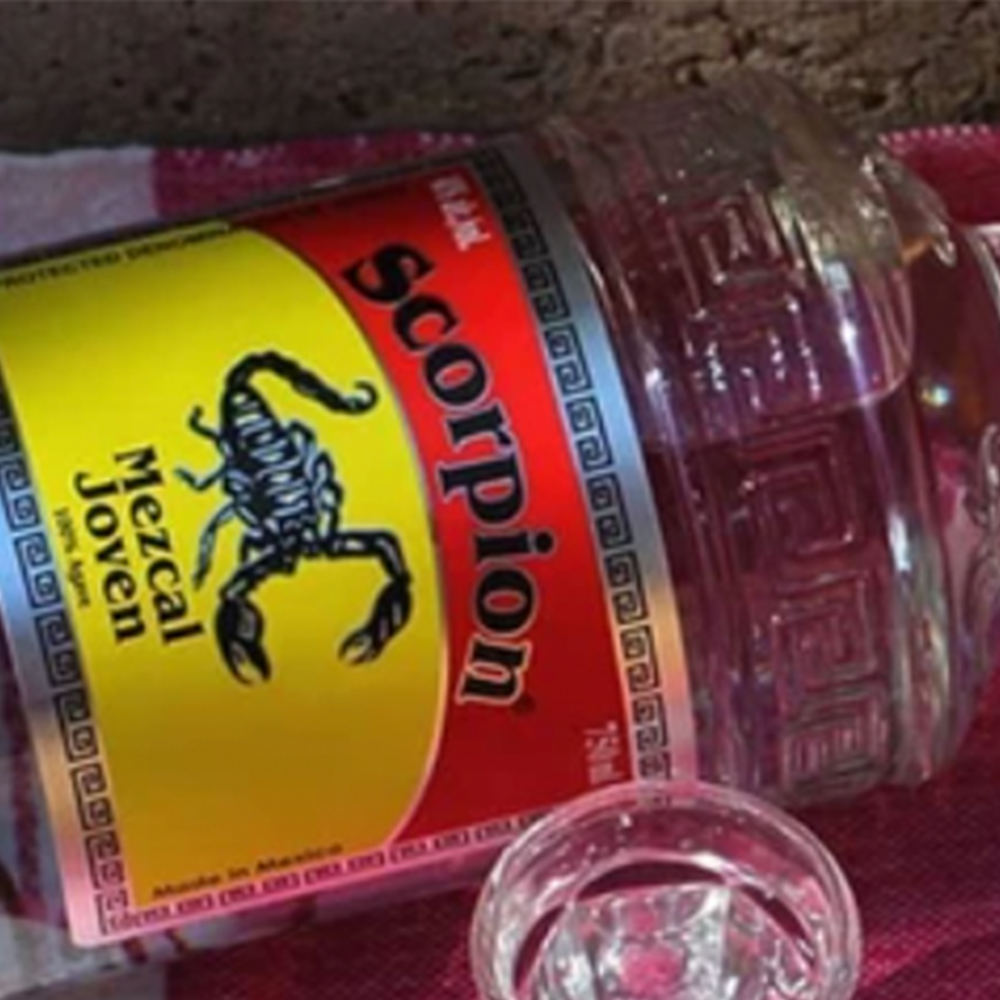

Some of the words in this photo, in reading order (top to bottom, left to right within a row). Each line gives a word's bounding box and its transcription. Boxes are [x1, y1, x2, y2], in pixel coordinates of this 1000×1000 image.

[73, 472, 146, 645] Joven
[114, 446, 205, 646] Mezcal
[342, 242, 556, 705] Scorpion
[152, 873, 222, 898] Made
[227, 866, 250, 881] in
[256, 843, 344, 873] Mexico
